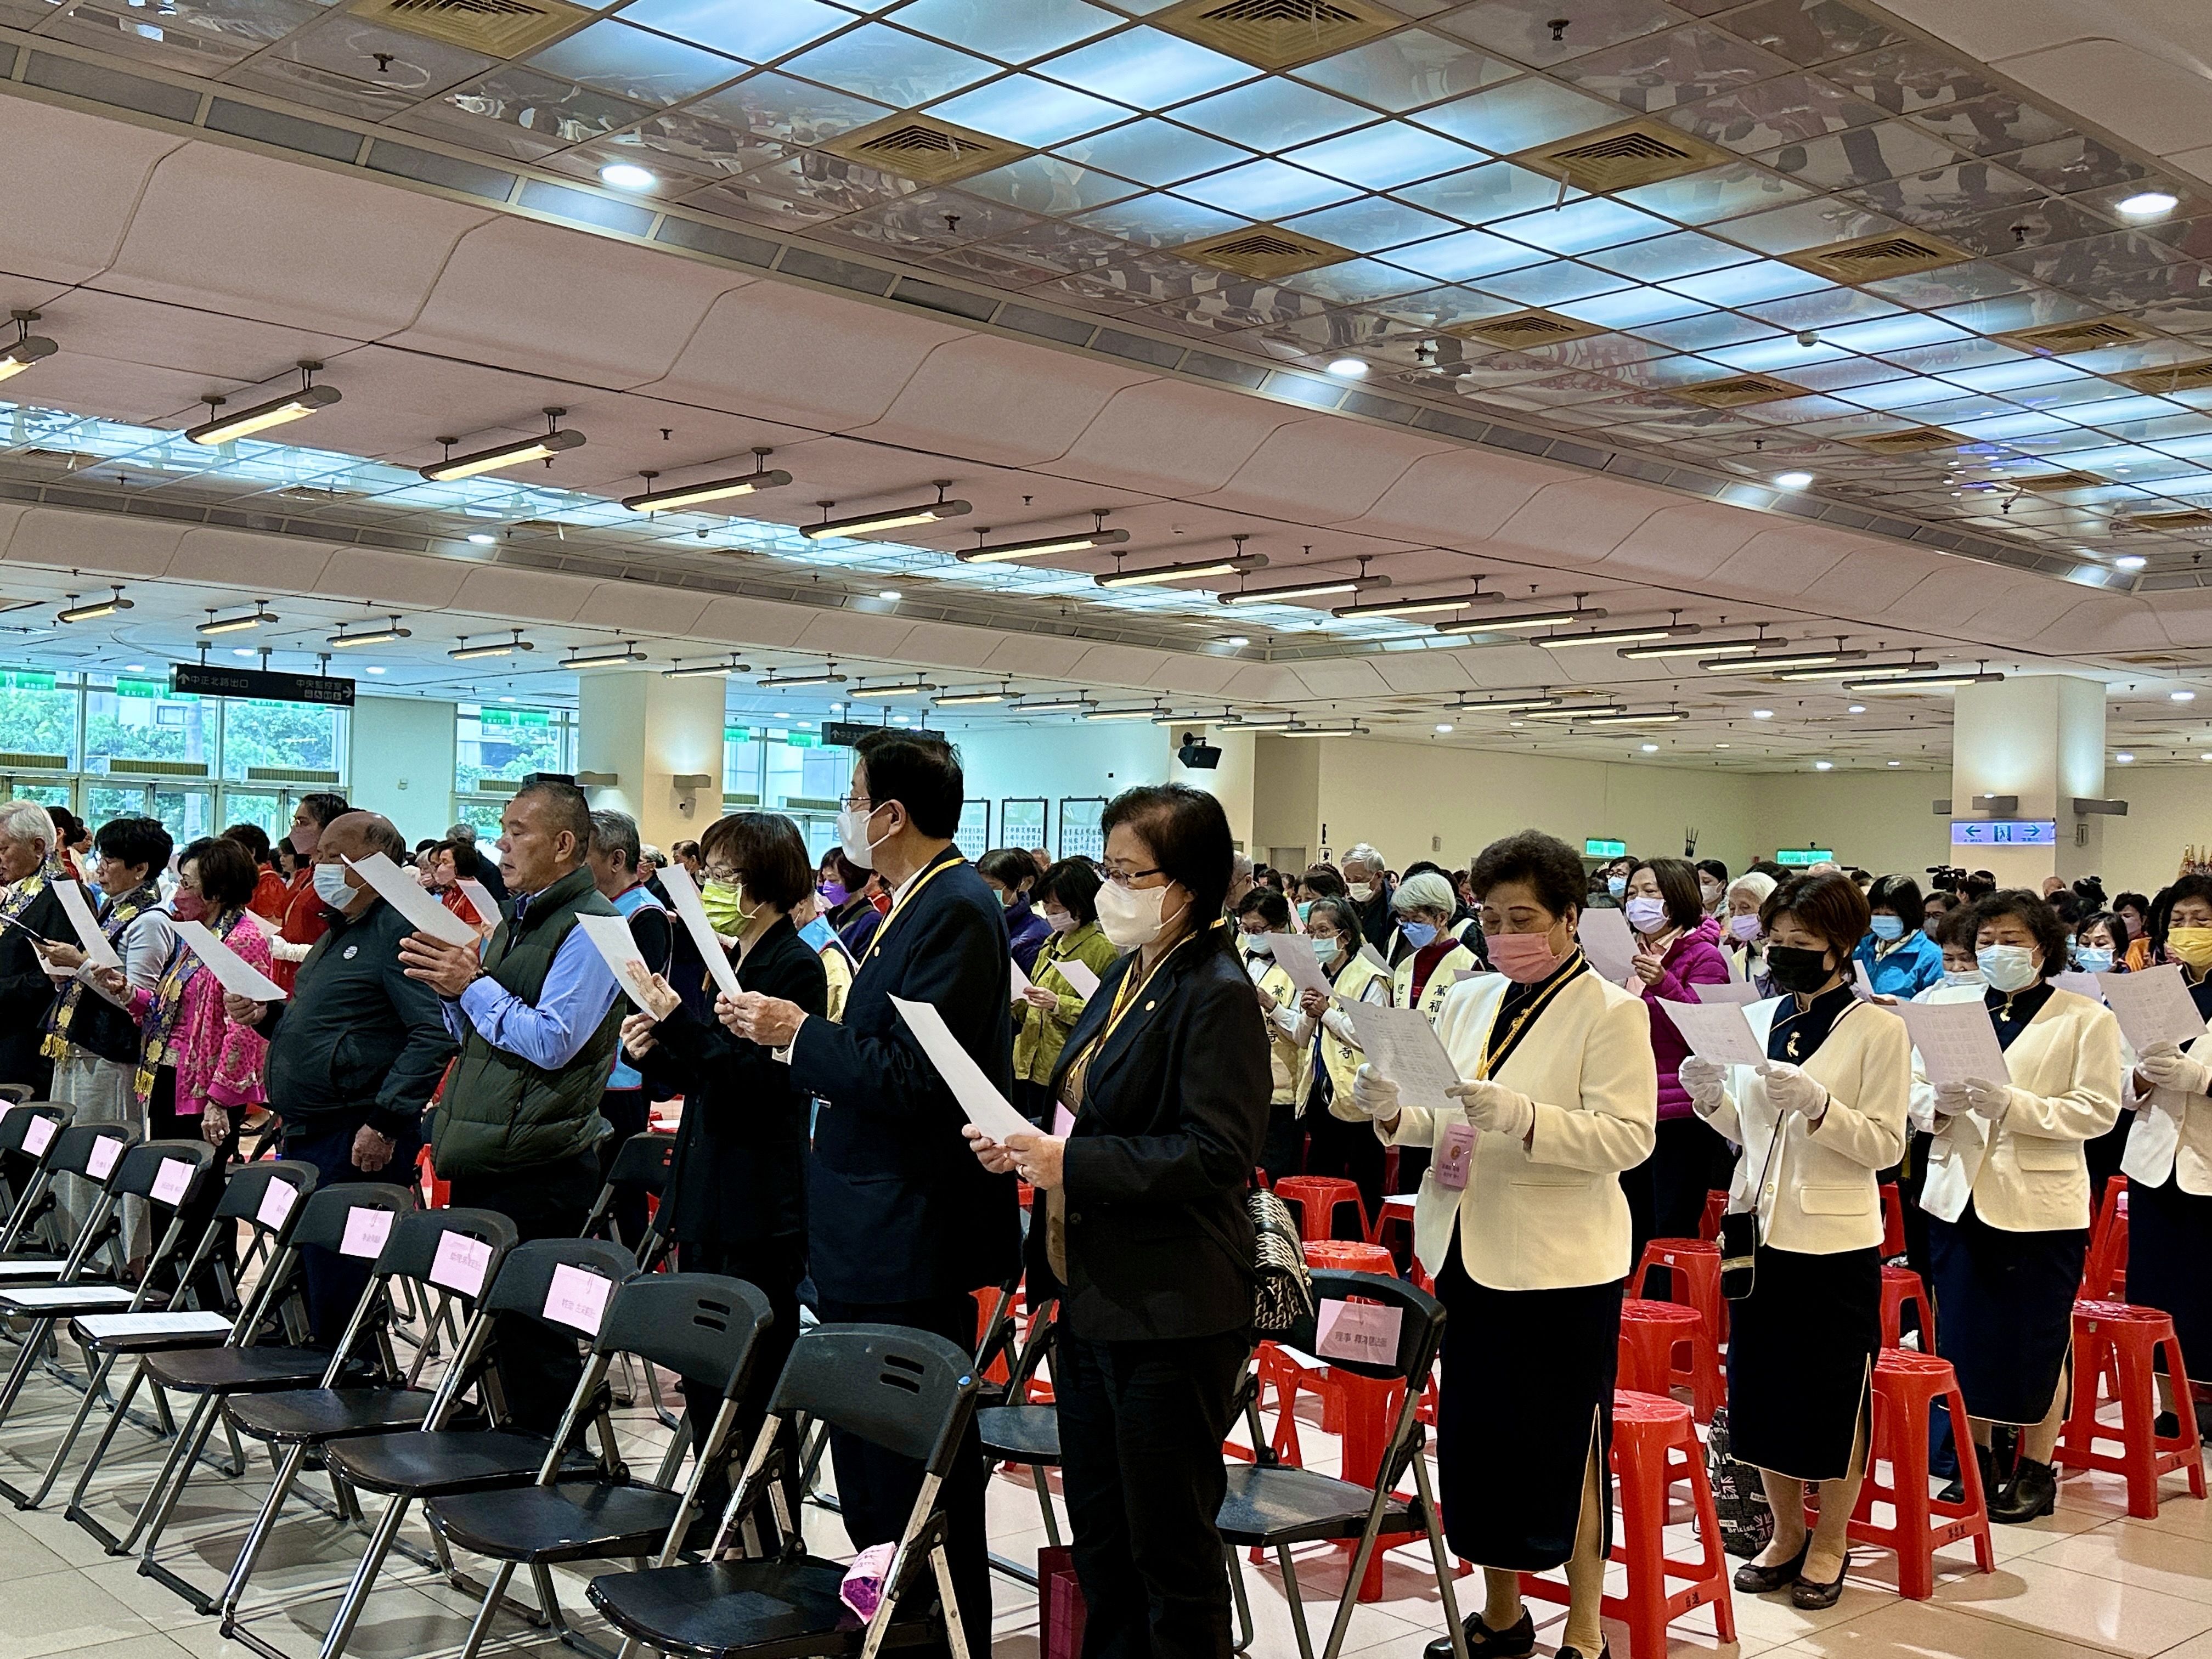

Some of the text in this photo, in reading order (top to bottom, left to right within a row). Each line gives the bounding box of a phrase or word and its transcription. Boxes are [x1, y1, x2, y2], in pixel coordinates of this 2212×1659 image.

[190, 675, 249, 689] 中正北路出口
[1727, 1525, 1756, 1533] British
